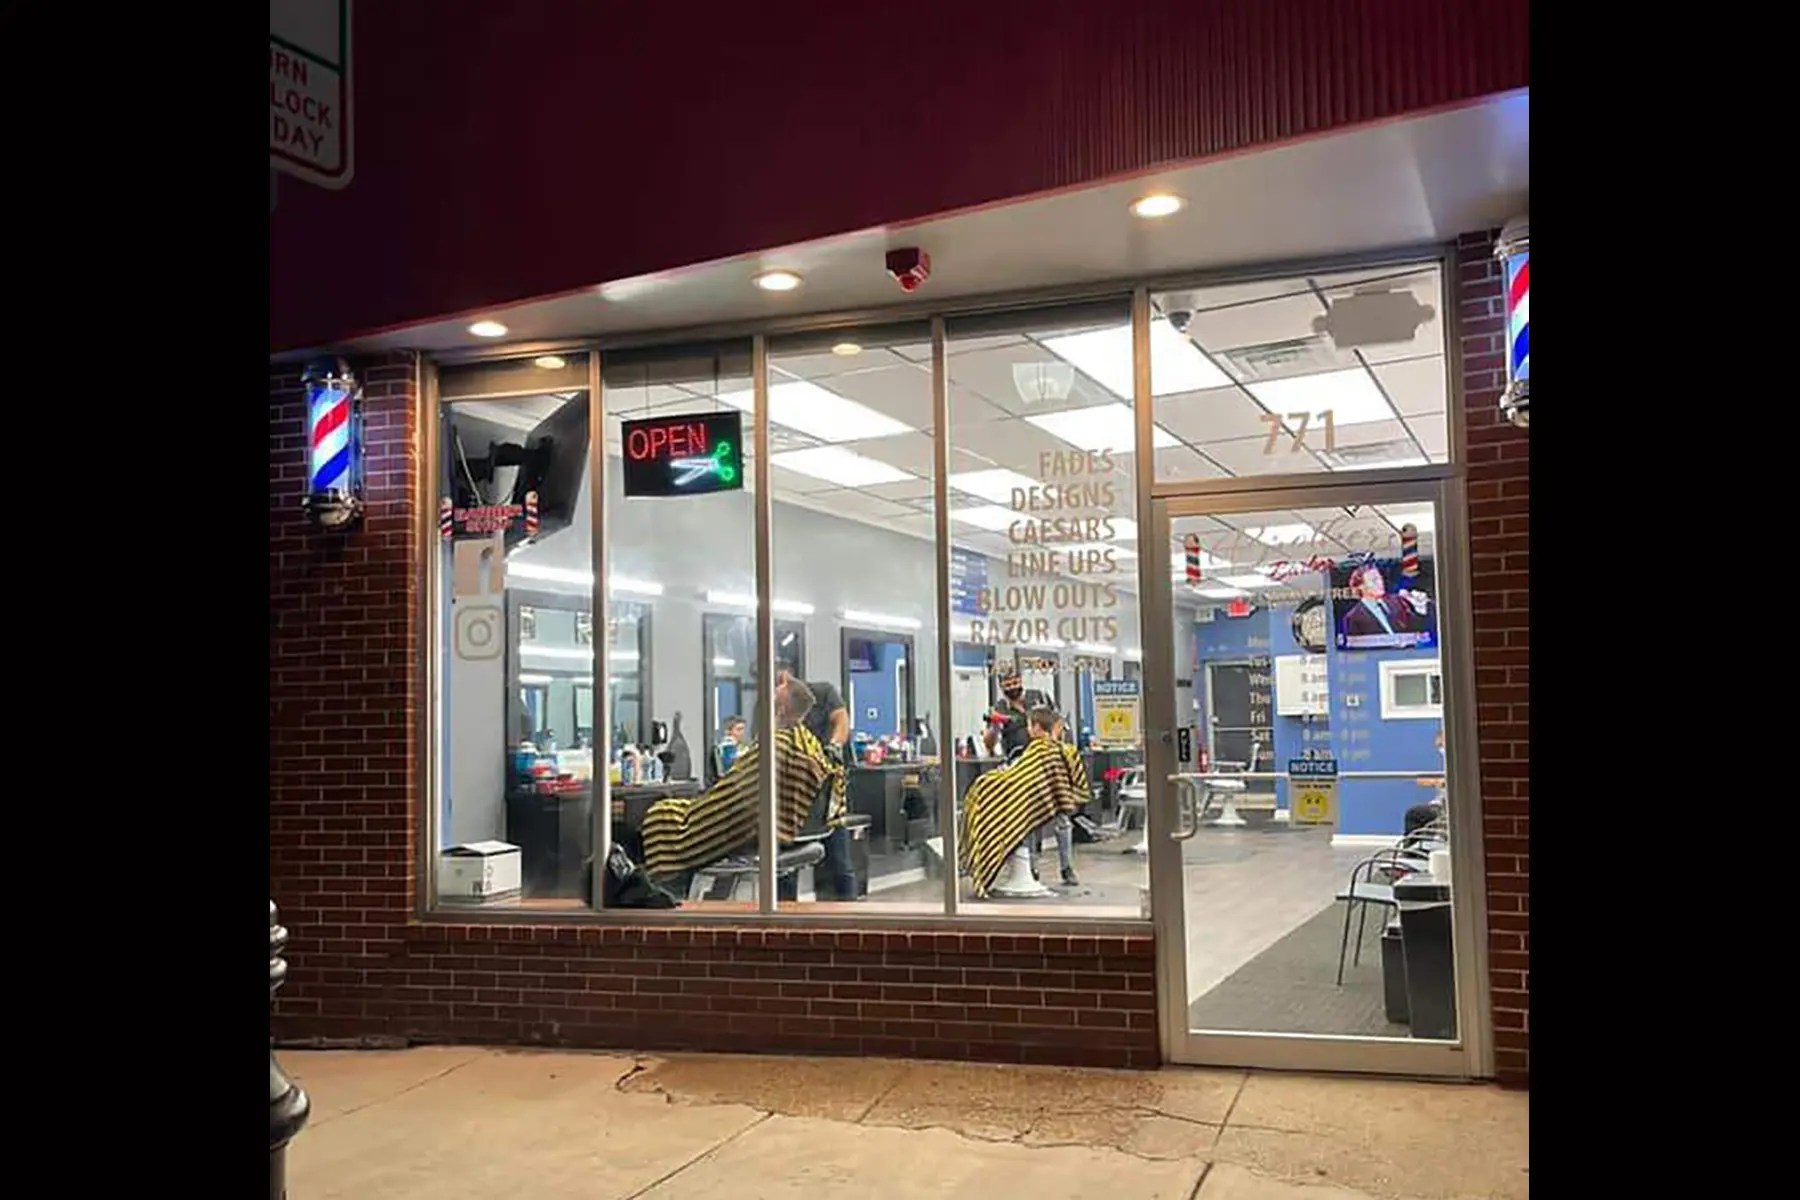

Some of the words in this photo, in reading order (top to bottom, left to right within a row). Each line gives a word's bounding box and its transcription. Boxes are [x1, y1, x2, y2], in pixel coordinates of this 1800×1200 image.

[270, 49, 308, 86] RN
[274, 113, 324, 157] DAY
[629, 423, 706, 459] OPEN
[1260, 409, 1336, 455] 771
[1039, 448, 1115, 479] FADES
[1011, 481, 1116, 512] DESIGNS
[1008, 515, 1116, 545] CAESARS
[1007, 552, 1061, 578] LINE
[1068, 549, 1117, 575] UPS
[977, 585, 1046, 614] BLOW
[1053, 582, 1118, 609] OUTS
[970, 618, 1050, 644] RAZOR
[1057, 615, 1119, 642] CUTS
[1095, 682, 1136, 694] NOTICE
[1250, 710, 1266, 723] Fri
[1250, 727, 1270, 742] Sat
[1290, 762, 1334, 773] NOTICE
